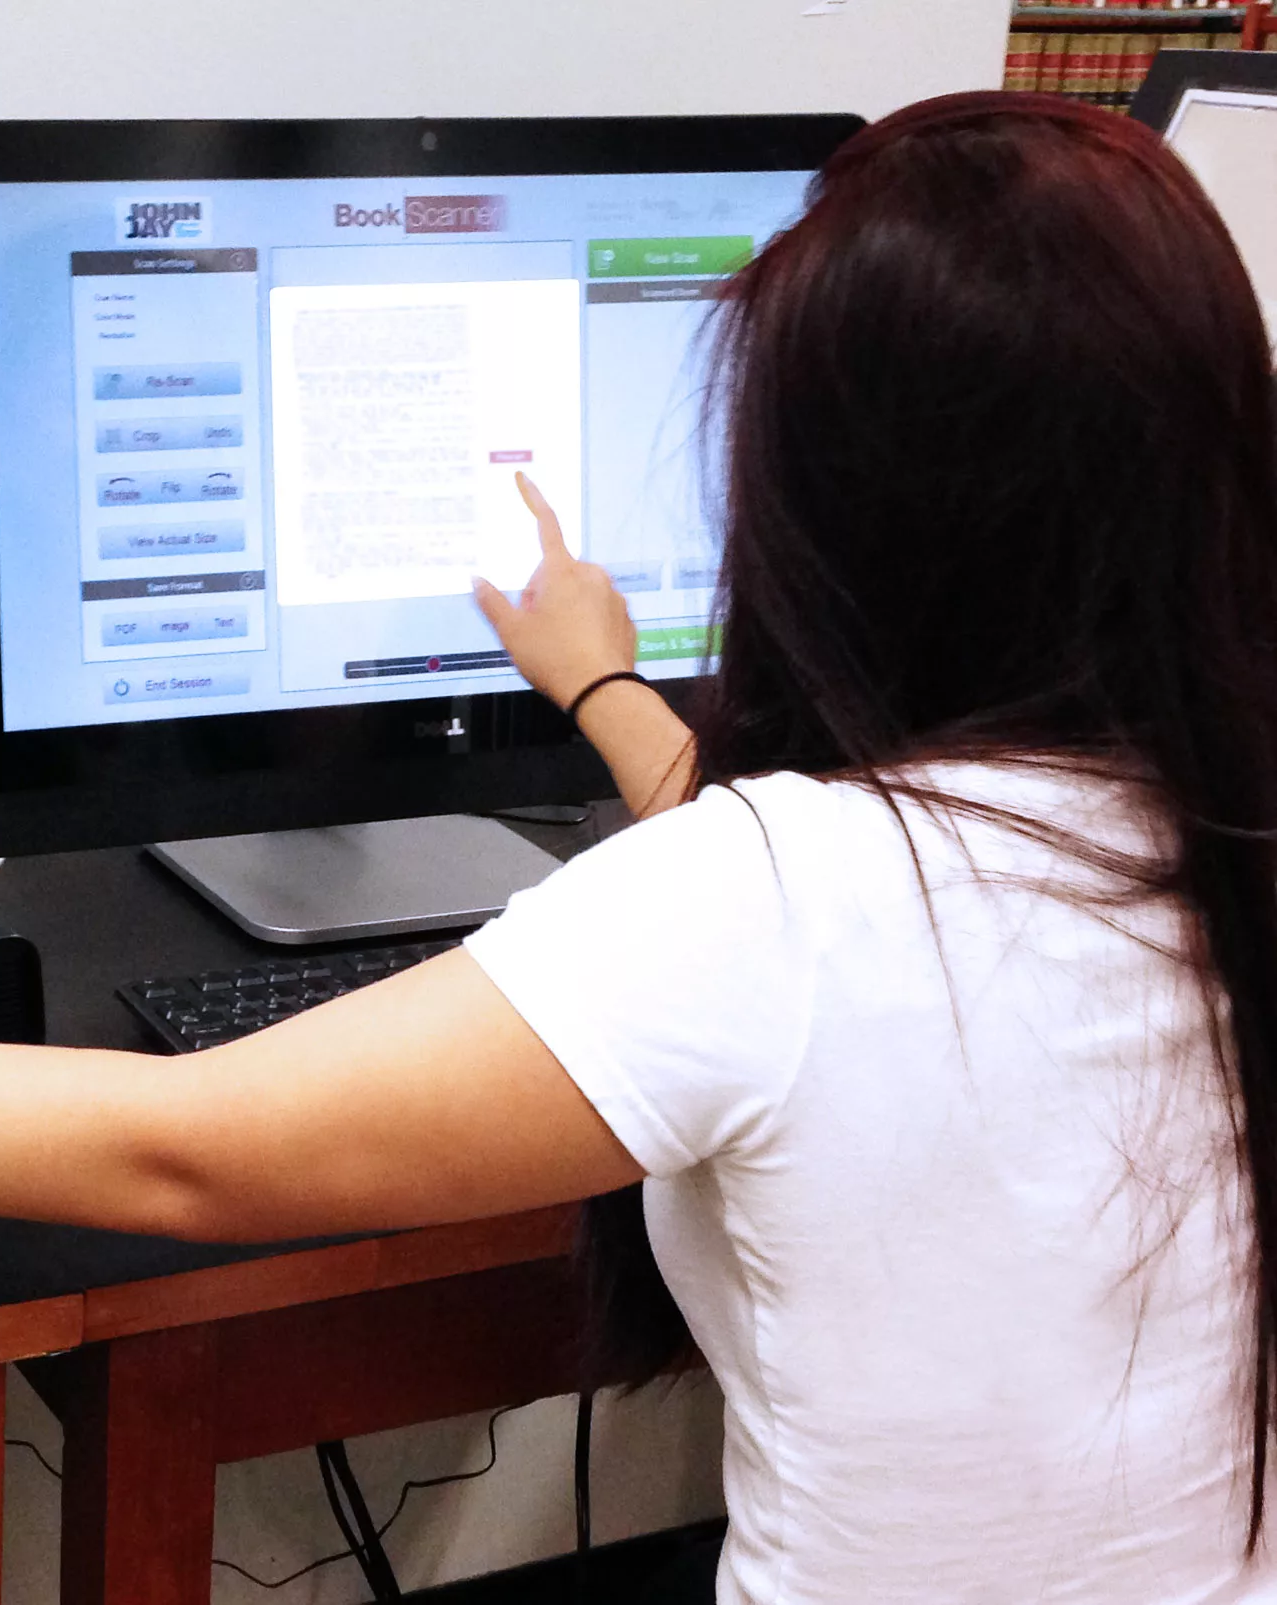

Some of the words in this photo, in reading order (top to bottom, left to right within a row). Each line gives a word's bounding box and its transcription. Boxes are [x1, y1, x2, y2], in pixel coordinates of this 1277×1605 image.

[126, 202, 200, 221] JOHN
[334, 203, 402, 227] Book
[407, 201, 501, 228] Scanner
[126, 219, 171, 238] JAY
[132, 430, 161, 443] Crop
[159, 622, 190, 633] mage
[145, 680, 167, 692] End
[170, 678, 213, 690] Session
